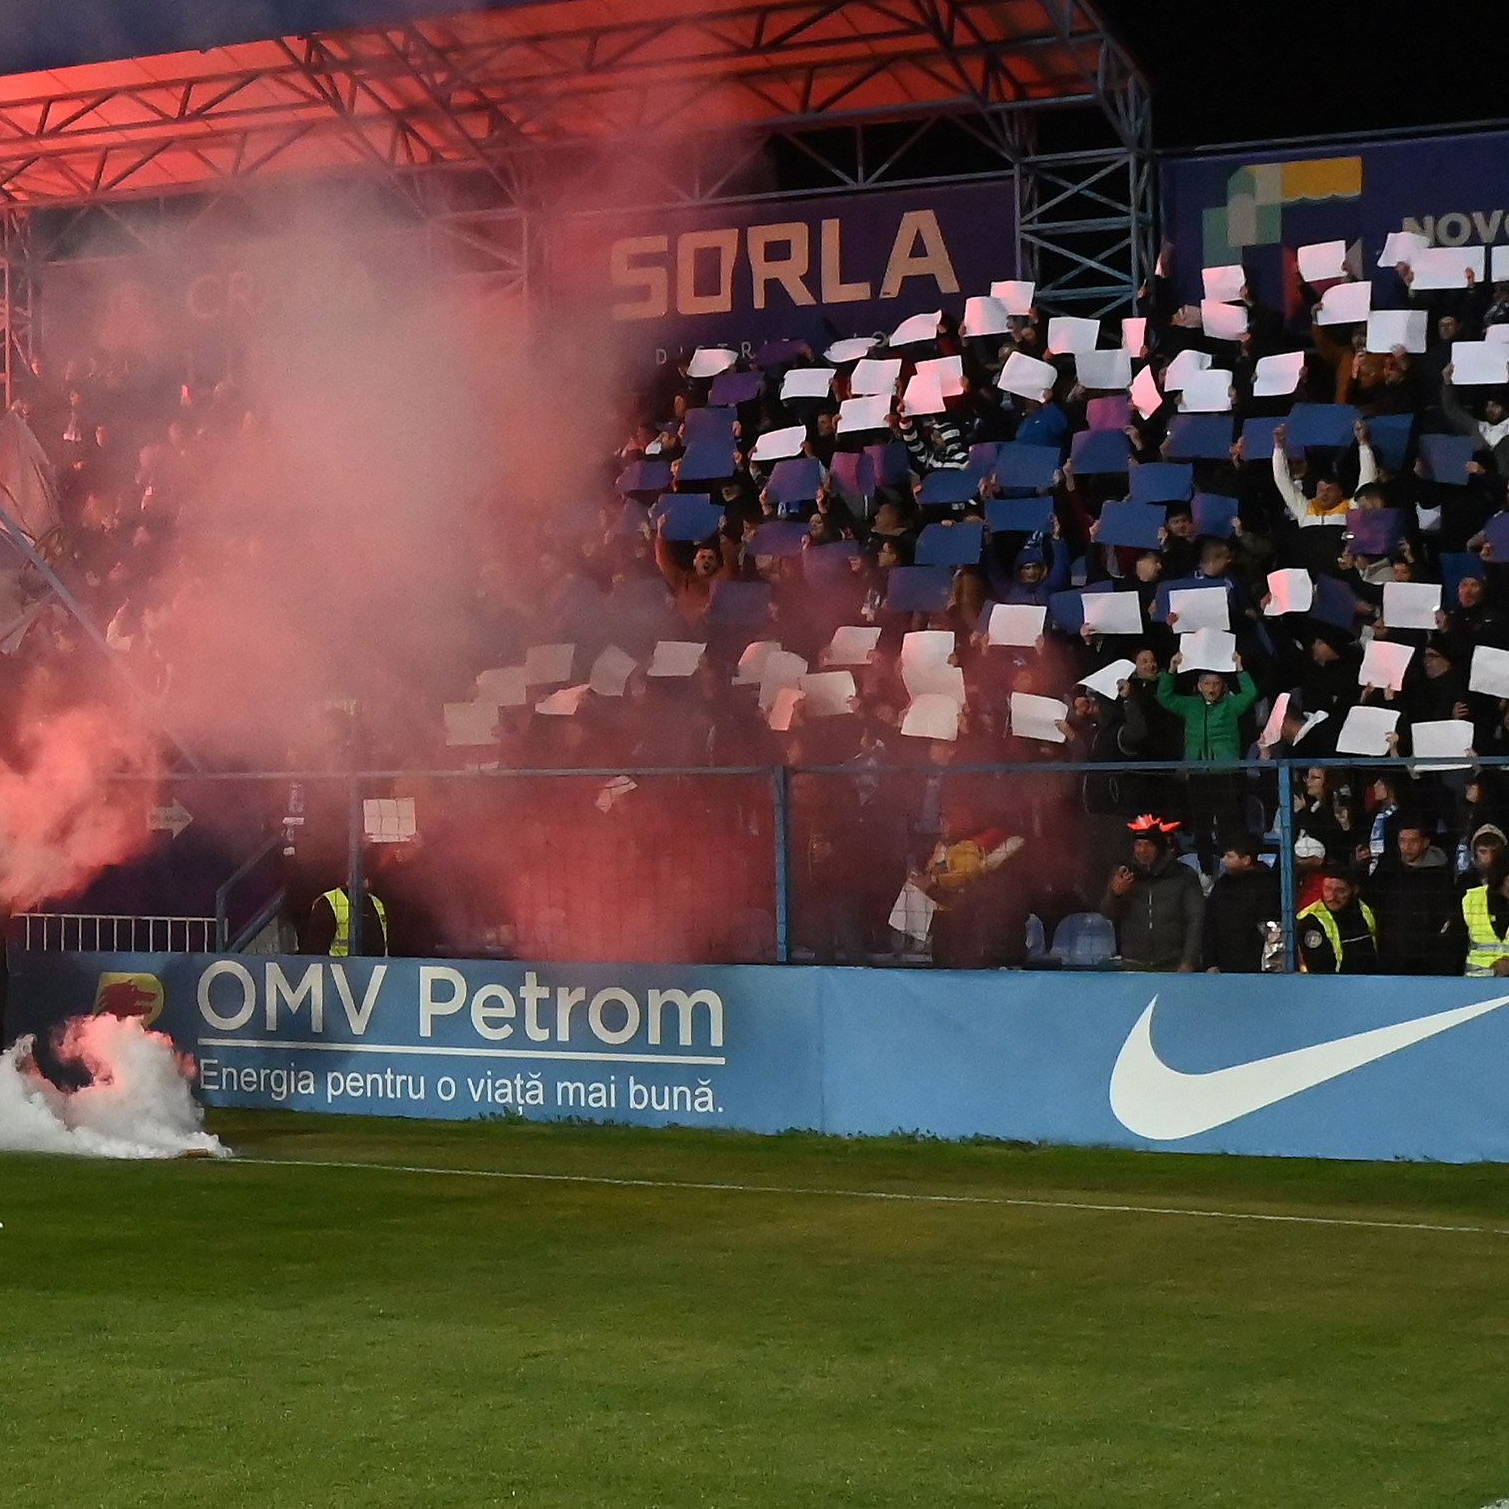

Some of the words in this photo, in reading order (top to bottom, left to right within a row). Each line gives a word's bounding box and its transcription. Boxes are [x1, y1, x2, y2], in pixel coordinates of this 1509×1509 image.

[611, 209, 960, 321] SORLA
[197, 960, 387, 1036] OMV
[419, 965, 725, 1047] Petrom
[199, 1058, 315, 1102] Energia
[326, 1071, 426, 1104] pentru
[437, 1075, 457, 1102] o
[467, 1070, 545, 1117] viață
[556, 1075, 617, 1108] mai
[628, 1076, 725, 1113] bună.
